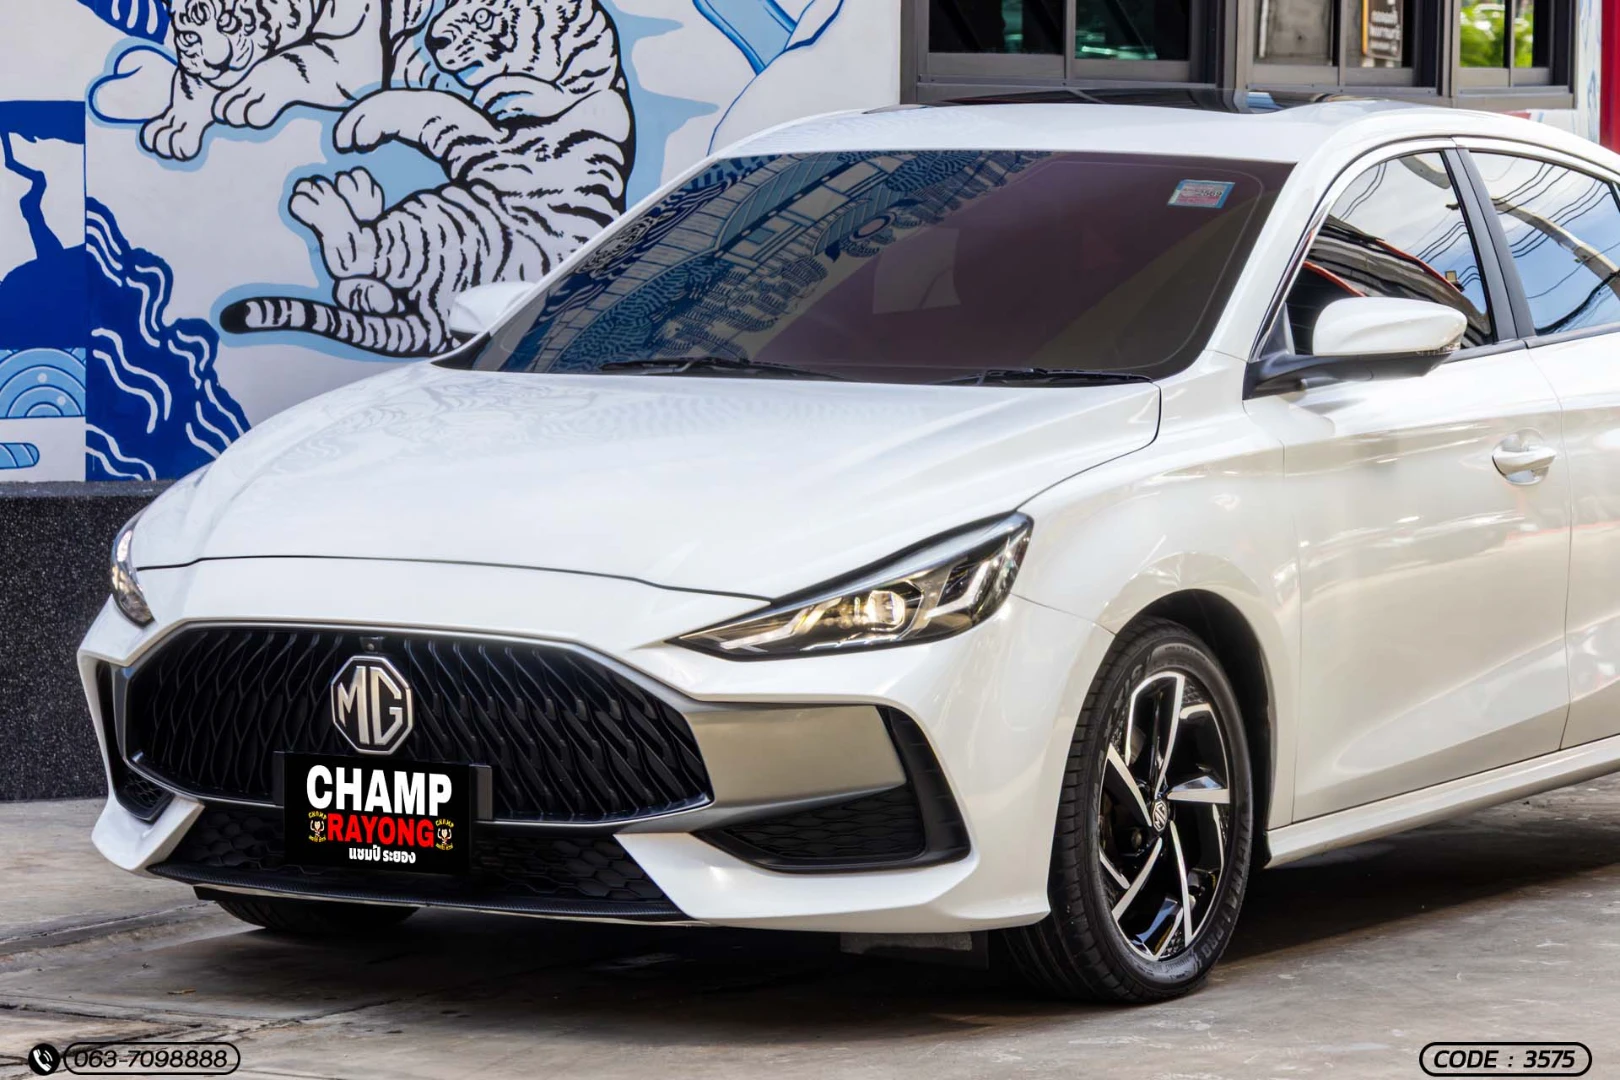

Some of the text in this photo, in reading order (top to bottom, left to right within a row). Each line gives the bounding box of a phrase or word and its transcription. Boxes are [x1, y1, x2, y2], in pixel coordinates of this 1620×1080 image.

[337, 665, 403, 746] MG
[306, 765, 452, 816] CHAMP
[327, 813, 434, 848] RAYONG
